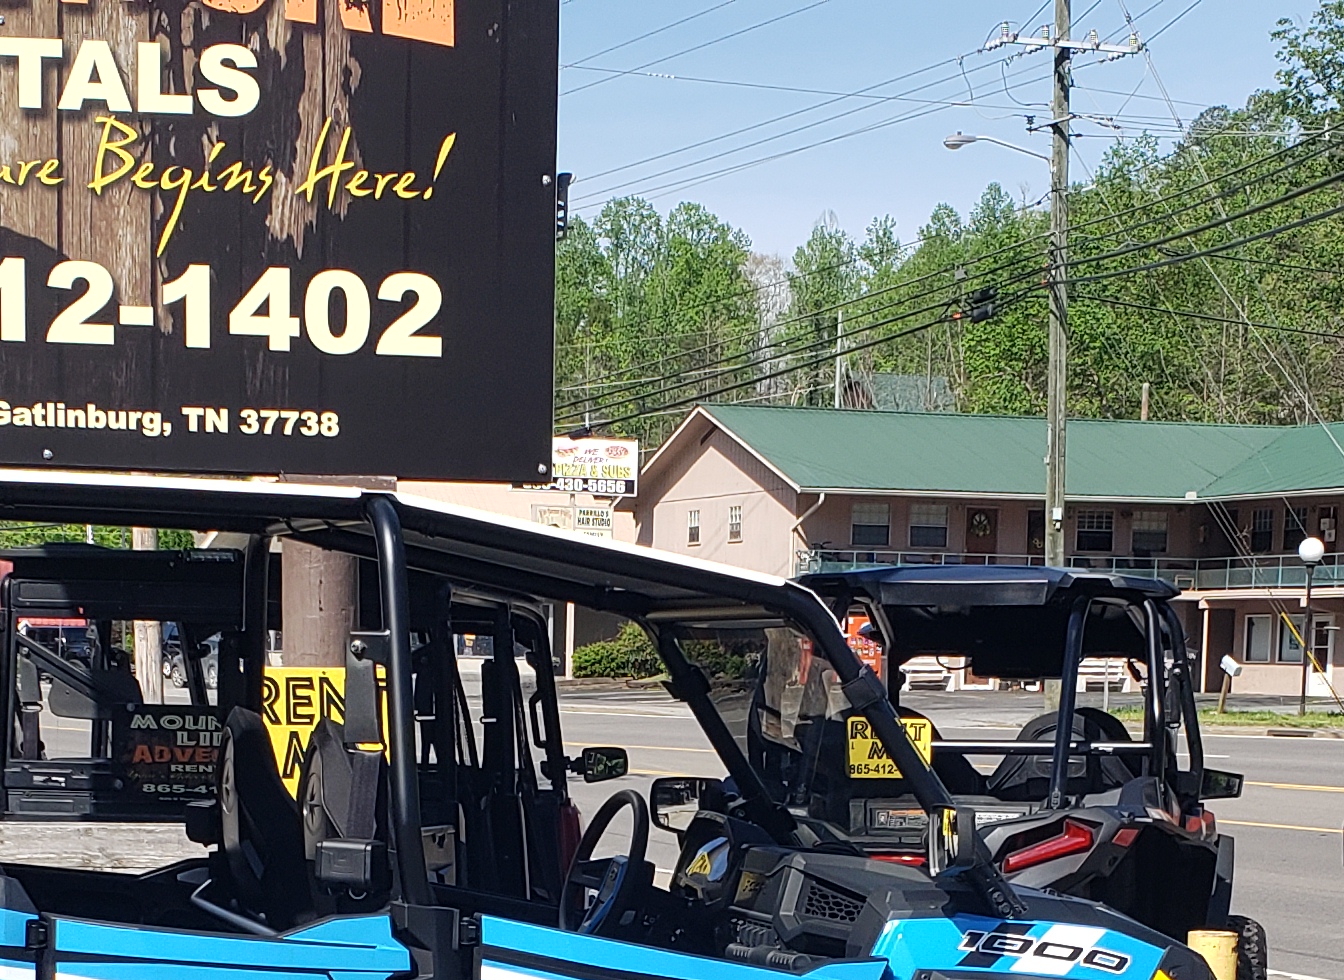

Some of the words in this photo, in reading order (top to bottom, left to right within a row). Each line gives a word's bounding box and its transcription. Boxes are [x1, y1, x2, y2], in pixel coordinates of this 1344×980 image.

[87, 115, 275, 258] Begins
[294, 117, 457, 210] Here!
[181, 406, 229, 433] TN
[239, 409, 340, 437] 37738
[553, 464, 587, 477] PIZZA
[590, 465, 599, 477] &
[601, 466, 631, 478] SUBS
[522, 478, 626, 493] -430-5656
[577, 517, 590, 526] HAIR
[592, 517, 611, 527] STUDIO
[130, 714, 222, 730] MOUN
[850, 720, 926, 742] RT
[132, 745, 220, 763] ADVE
[170, 764, 216, 772] REN
[849, 764, 898, 775] 865-412-
[142, 784, 218, 794] 865-41
[957, 929, 1131, 975] 1000
